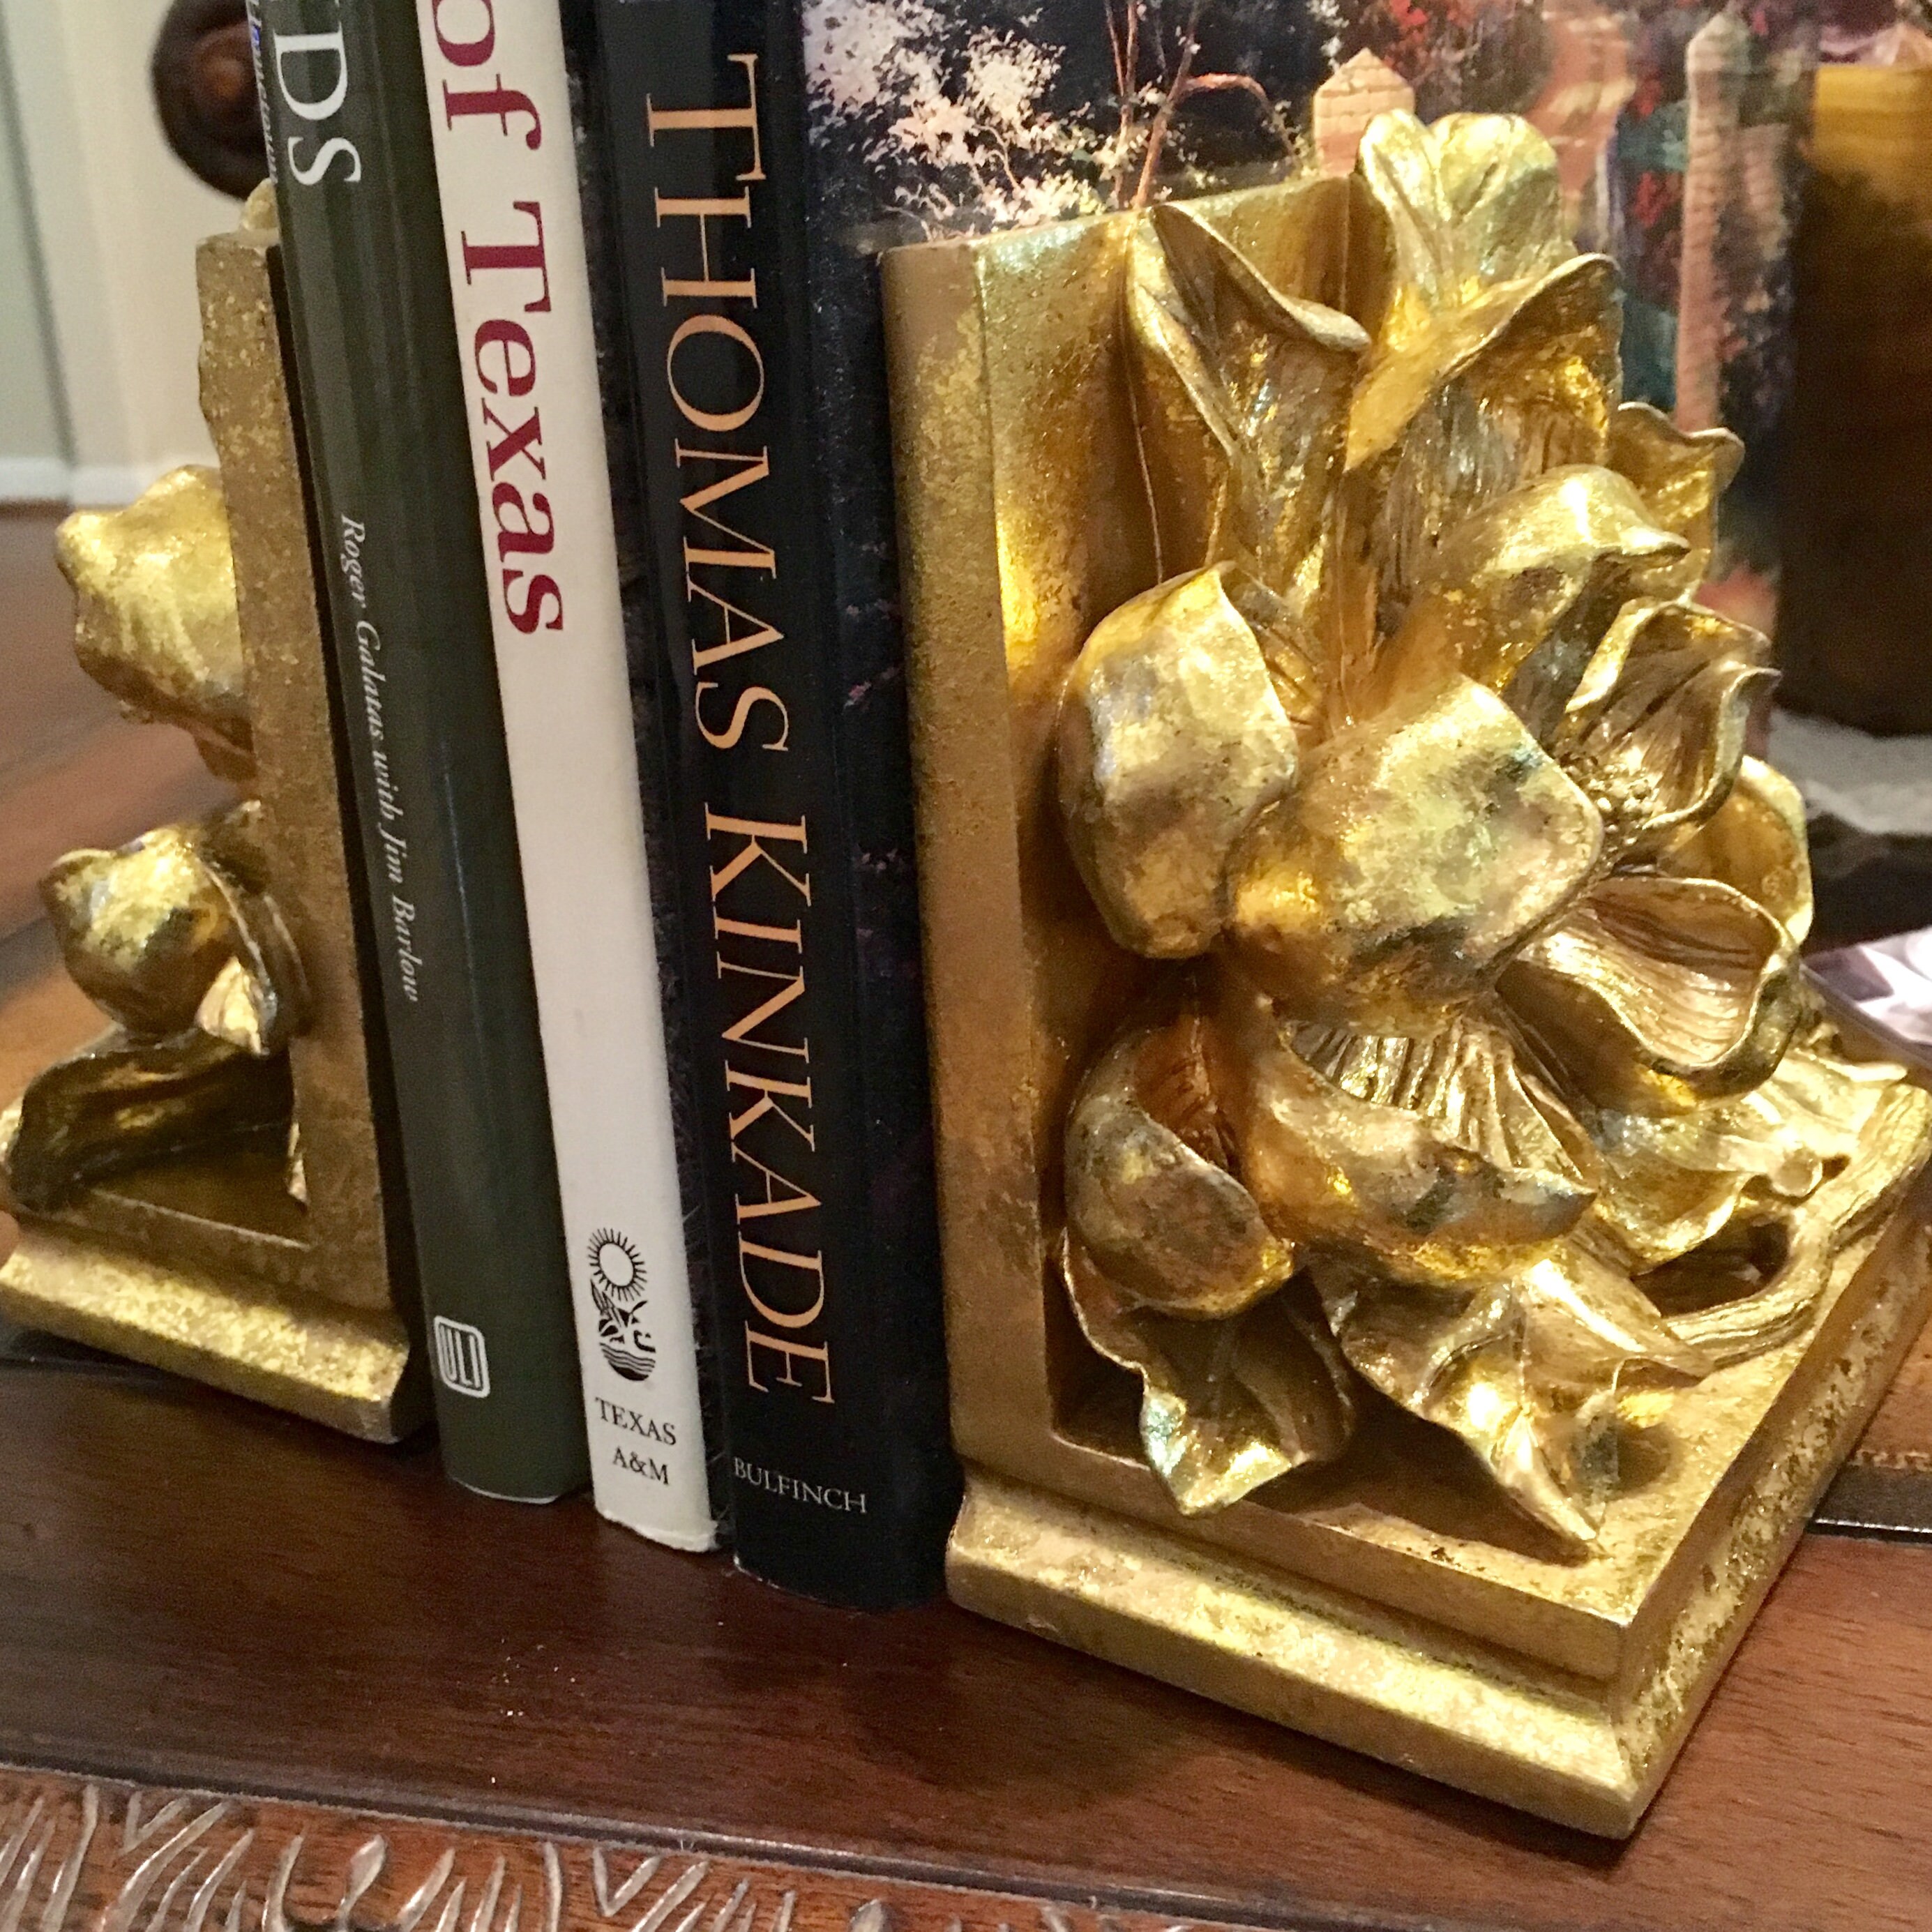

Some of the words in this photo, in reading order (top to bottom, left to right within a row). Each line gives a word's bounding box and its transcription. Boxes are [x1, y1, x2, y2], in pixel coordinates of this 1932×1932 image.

[273, 0, 361, 186] DS
[461, 201, 564, 634] Texas
[647, 53, 789, 752] THOMAS
[340, 514, 365, 609] Roger
[356, 621, 386, 741] Galatas
[373, 750, 404, 820] with
[377, 822, 407, 884] Jim
[392, 894, 423, 1002] Barlow
[704, 802, 835, 1404] KINKADE
[595, 1396, 677, 1445] TEXAS
[612, 1445, 669, 1485] A&M
[734, 1456, 868, 1514] BULFINCH
